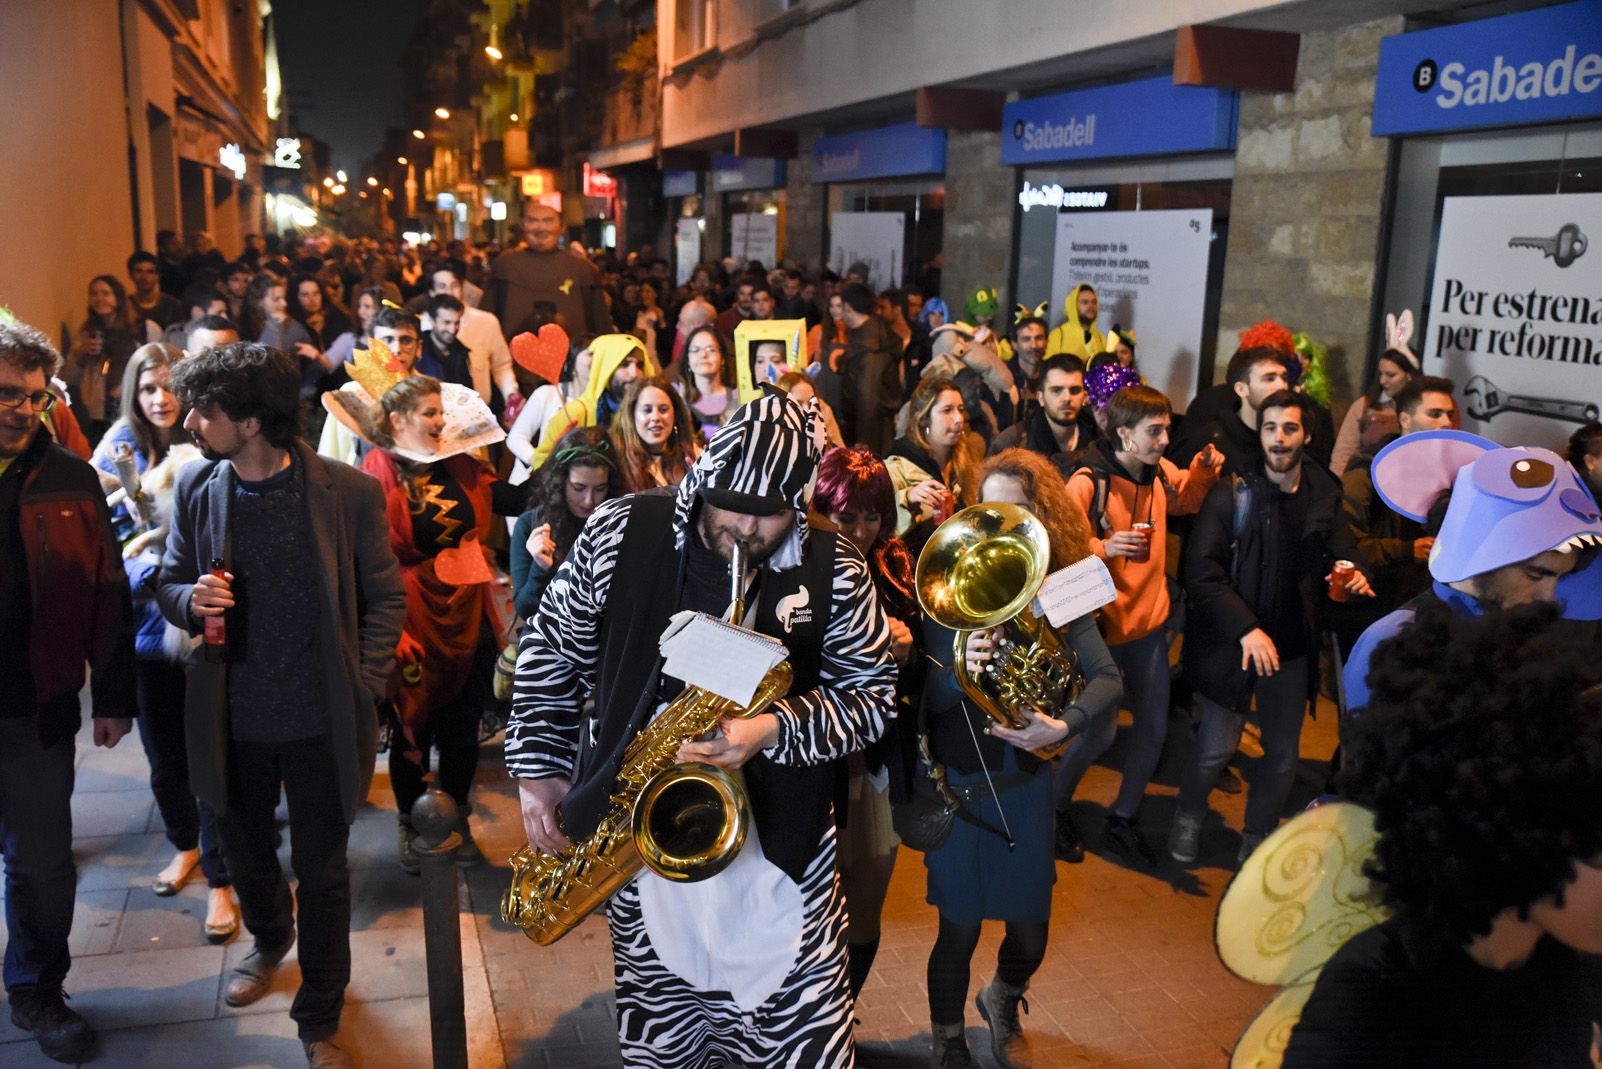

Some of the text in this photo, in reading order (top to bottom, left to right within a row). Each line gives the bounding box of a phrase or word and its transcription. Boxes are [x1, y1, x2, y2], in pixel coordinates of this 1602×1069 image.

[1418, 45, 1602, 109] B Sabade
[1023, 114, 1096, 152] Sabadell
[1442, 279, 1602, 325] Per estrena
[1434, 323, 1483, 359] per
[796, 608, 812, 616] banda
